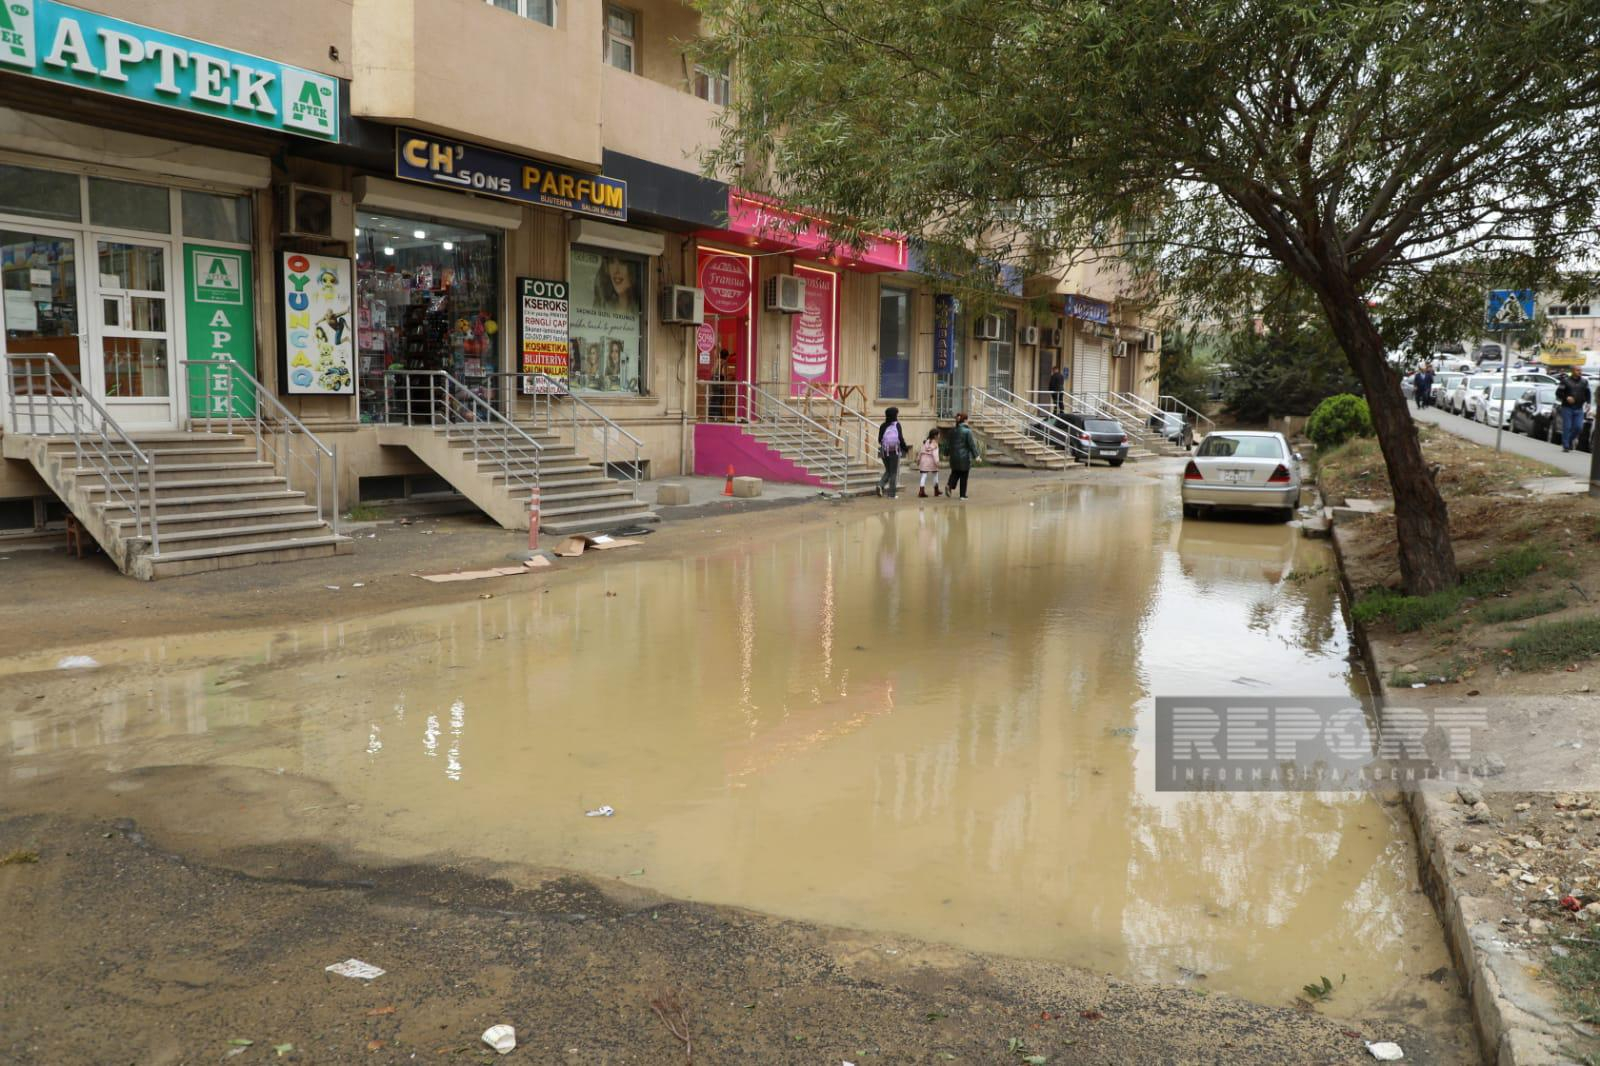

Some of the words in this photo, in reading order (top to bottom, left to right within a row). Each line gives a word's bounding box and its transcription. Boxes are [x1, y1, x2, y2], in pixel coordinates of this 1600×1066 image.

[44, 17, 277, 115] APTEK
[292, 102, 327, 118] APTEK
[458, 170, 512, 192] SONS
[522, 166, 623, 209] PARFUM
[524, 280, 566, 298] FOTO
[524, 297, 568, 312] KSEROKS
[287, 255, 314, 388] OYUNCAQ
[552, 319, 567, 328] ÇAP
[209, 310, 237, 412] APTEK
